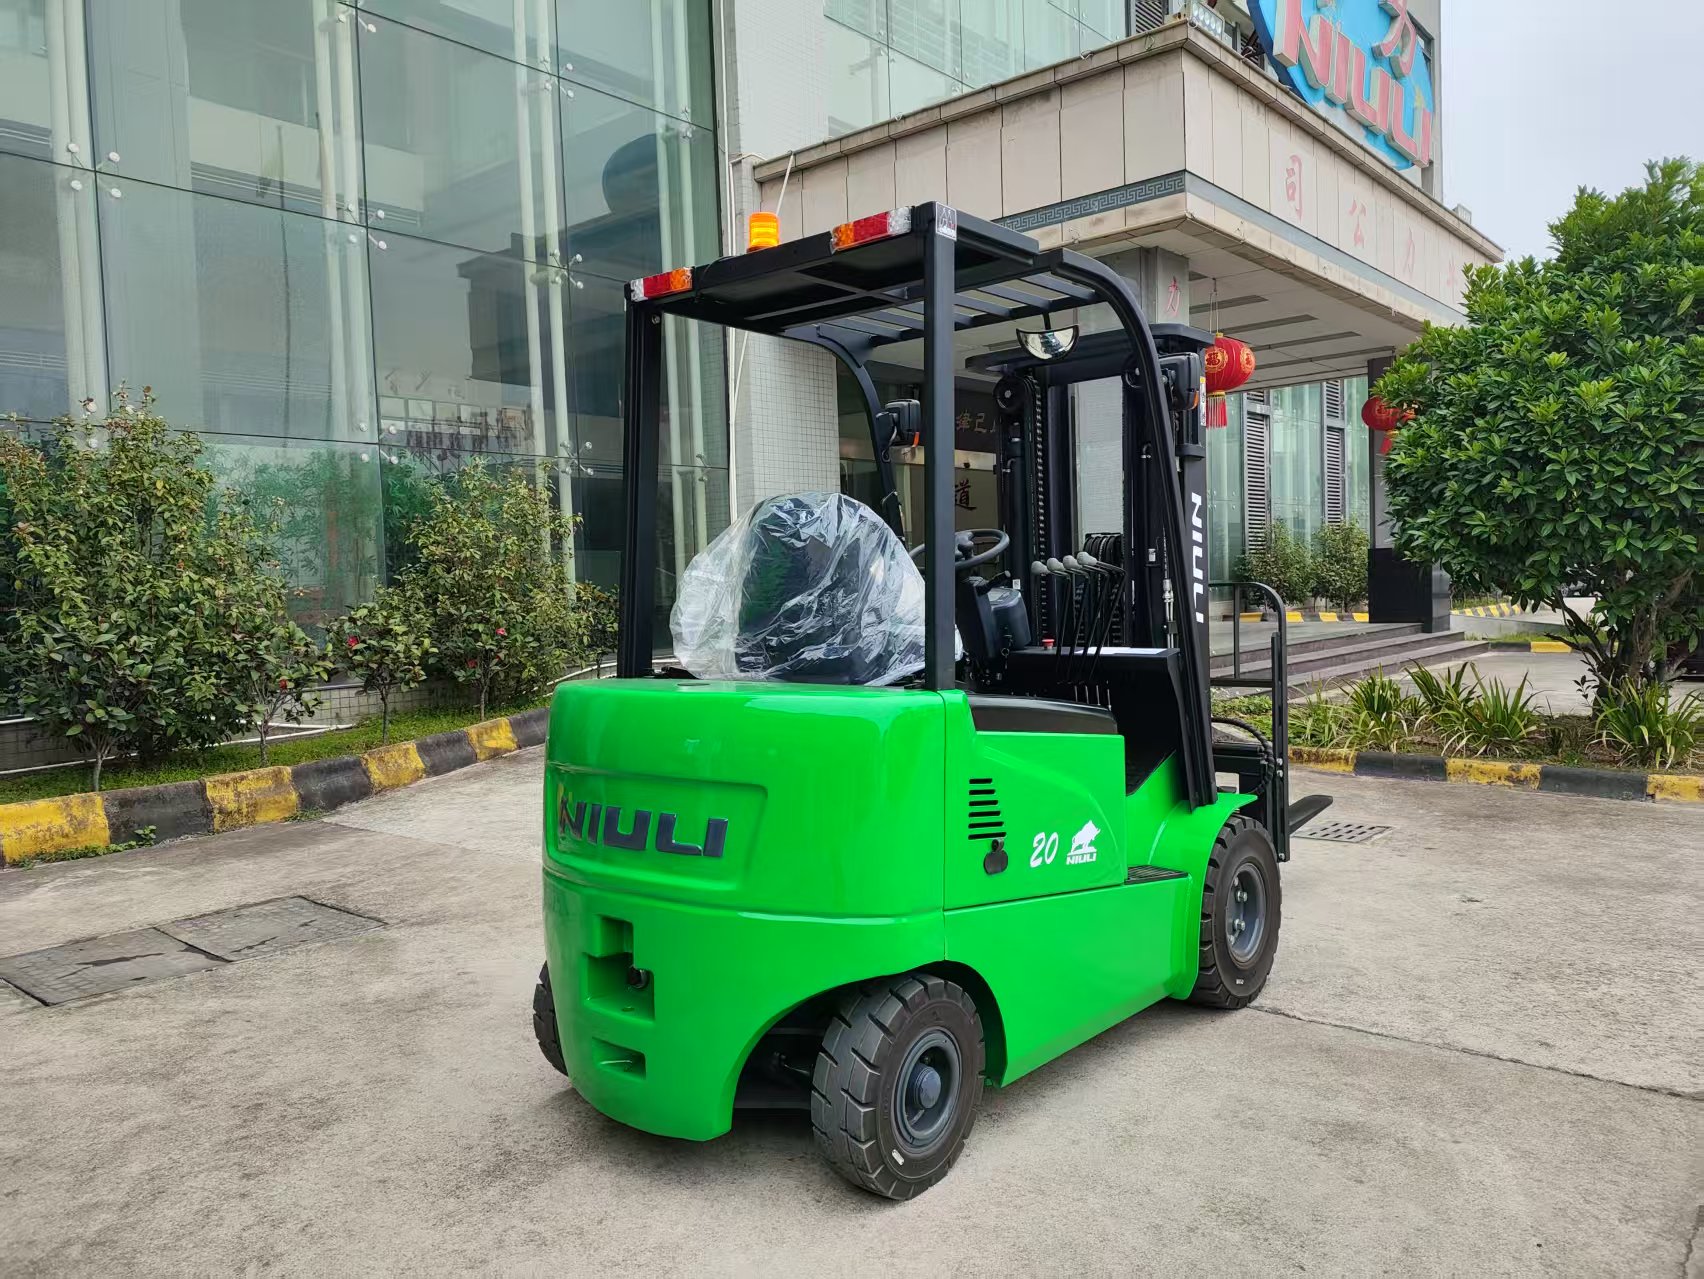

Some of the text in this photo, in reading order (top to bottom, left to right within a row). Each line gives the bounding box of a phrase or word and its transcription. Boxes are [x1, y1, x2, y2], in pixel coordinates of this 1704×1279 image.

[1276, 0, 1431, 167] NIULI
[955, 478, 977, 511] 道
[1191, 492, 1204, 623] NIULI
[558, 788, 729, 858] NIULI
[1030, 832, 1059, 868] 20
[1066, 851, 1097, 865] NIULI
